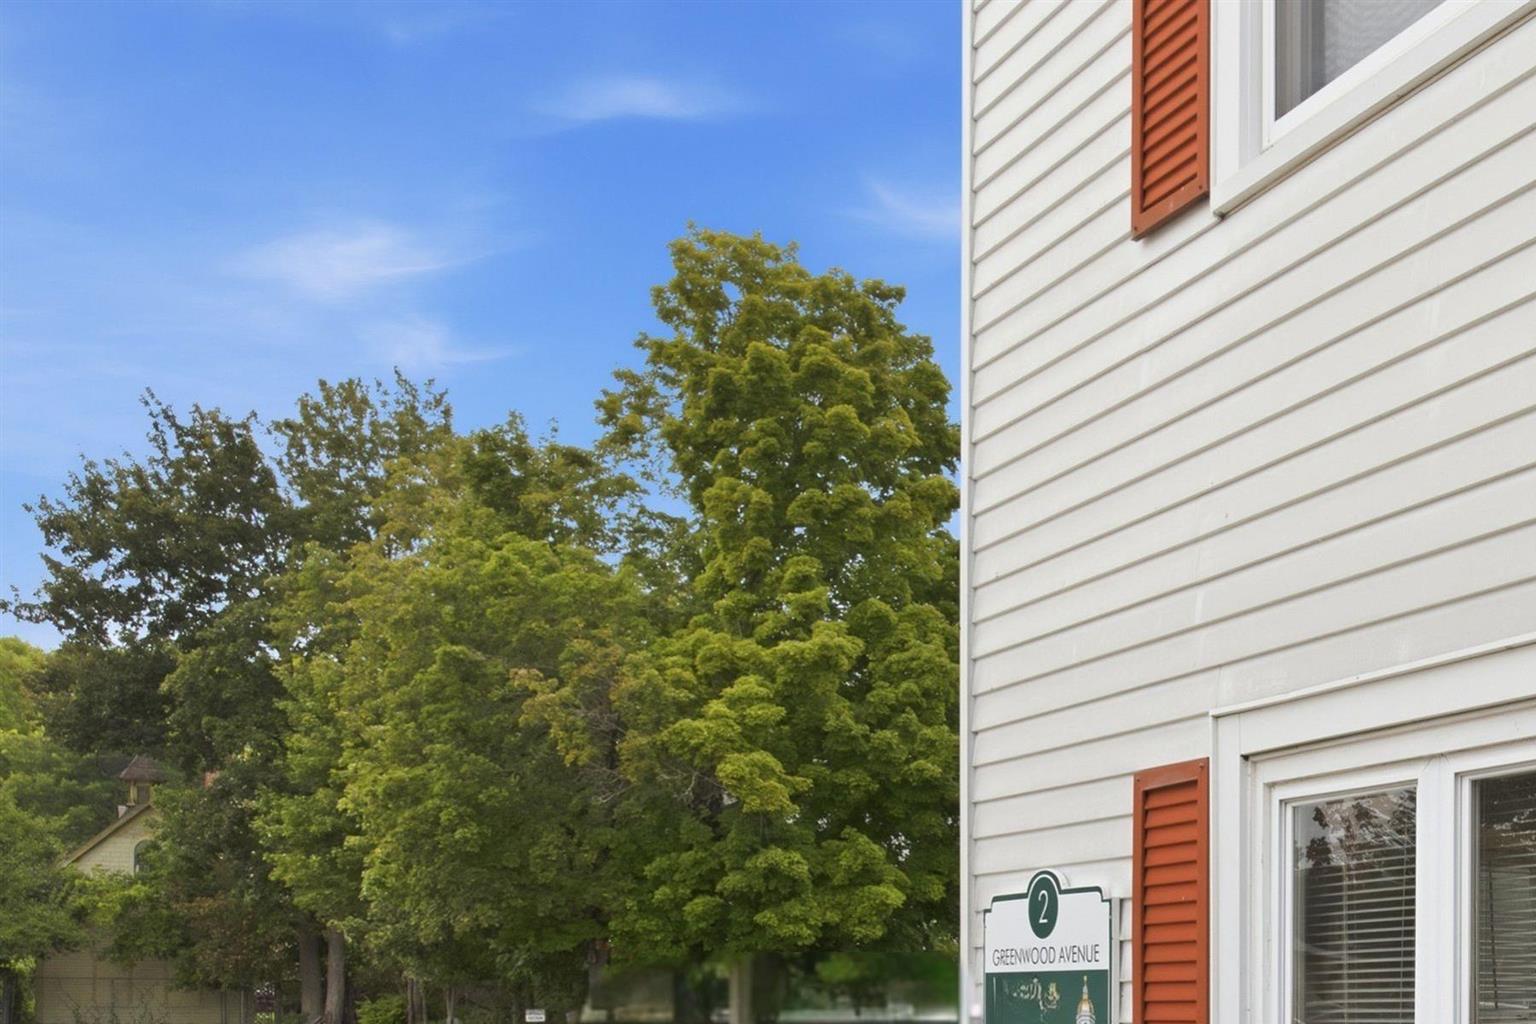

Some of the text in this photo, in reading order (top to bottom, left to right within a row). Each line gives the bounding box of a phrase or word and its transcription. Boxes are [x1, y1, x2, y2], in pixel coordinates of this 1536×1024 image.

[1038, 889, 1049, 924] 2
[992, 943, 1100, 967] GREENWOOD AVENUE
